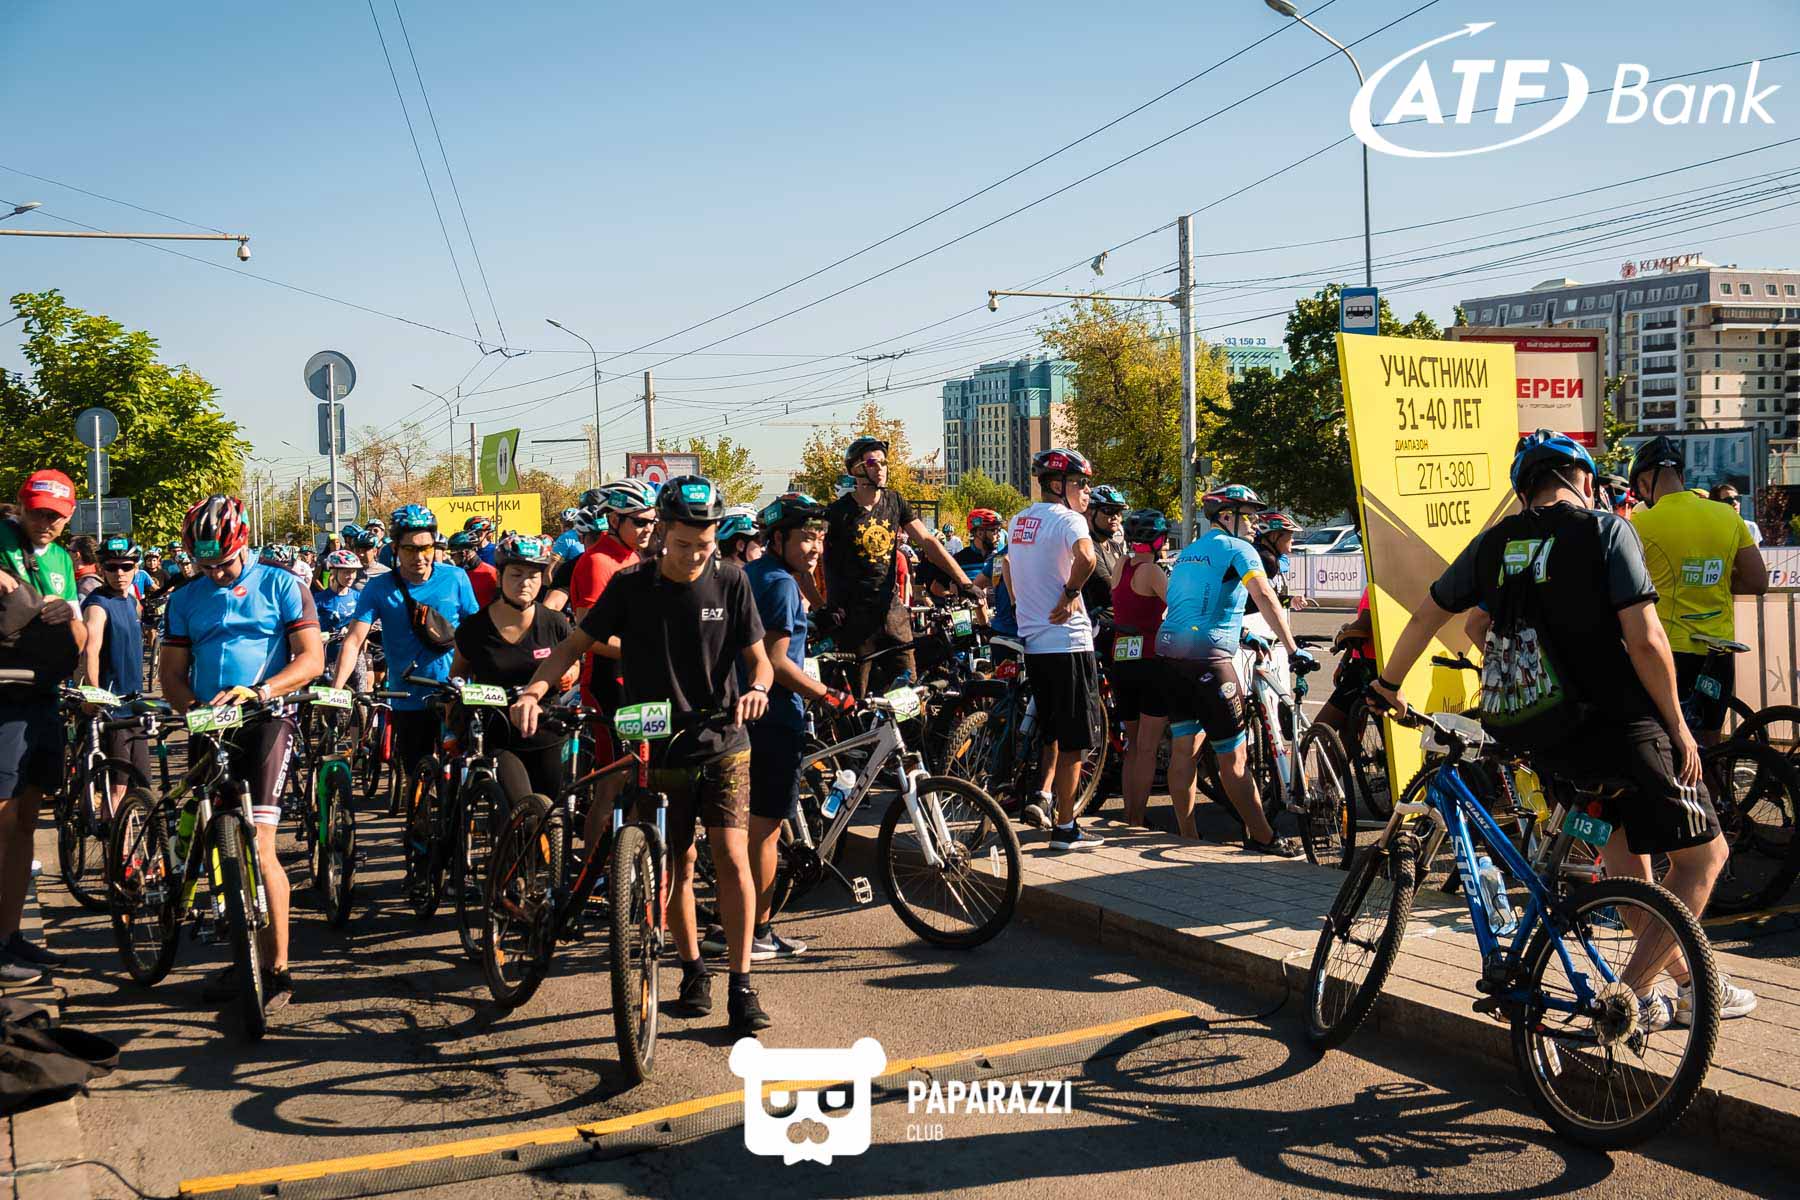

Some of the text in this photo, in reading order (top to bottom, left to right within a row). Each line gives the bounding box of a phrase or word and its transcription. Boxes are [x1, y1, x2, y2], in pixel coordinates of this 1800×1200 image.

[1379, 354, 1489, 389] УЧАСТНИКИ
[1396, 397, 1482, 430] 31-40 ЛЕТ
[1394, 439, 1429, 452] ДИАПАЗОН
[1417, 460, 1475, 491] 271-380
[449, 500, 521, 513] УЧАСТНИКИ
[1425, 500, 1472, 528] ШОССЕ
[1328, 572, 1358, 582] GROUP
[1685, 572, 1699, 582] 119
[1705, 573, 1719, 583] 119
[701, 607, 724, 618] EA7
[1130, 648, 1138, 656] 63
[216, 711, 237, 723] 567
[643, 720, 666, 733] 459
[1464, 800, 1491, 830] GIANT
[1572, 817, 1594, 835] 113
